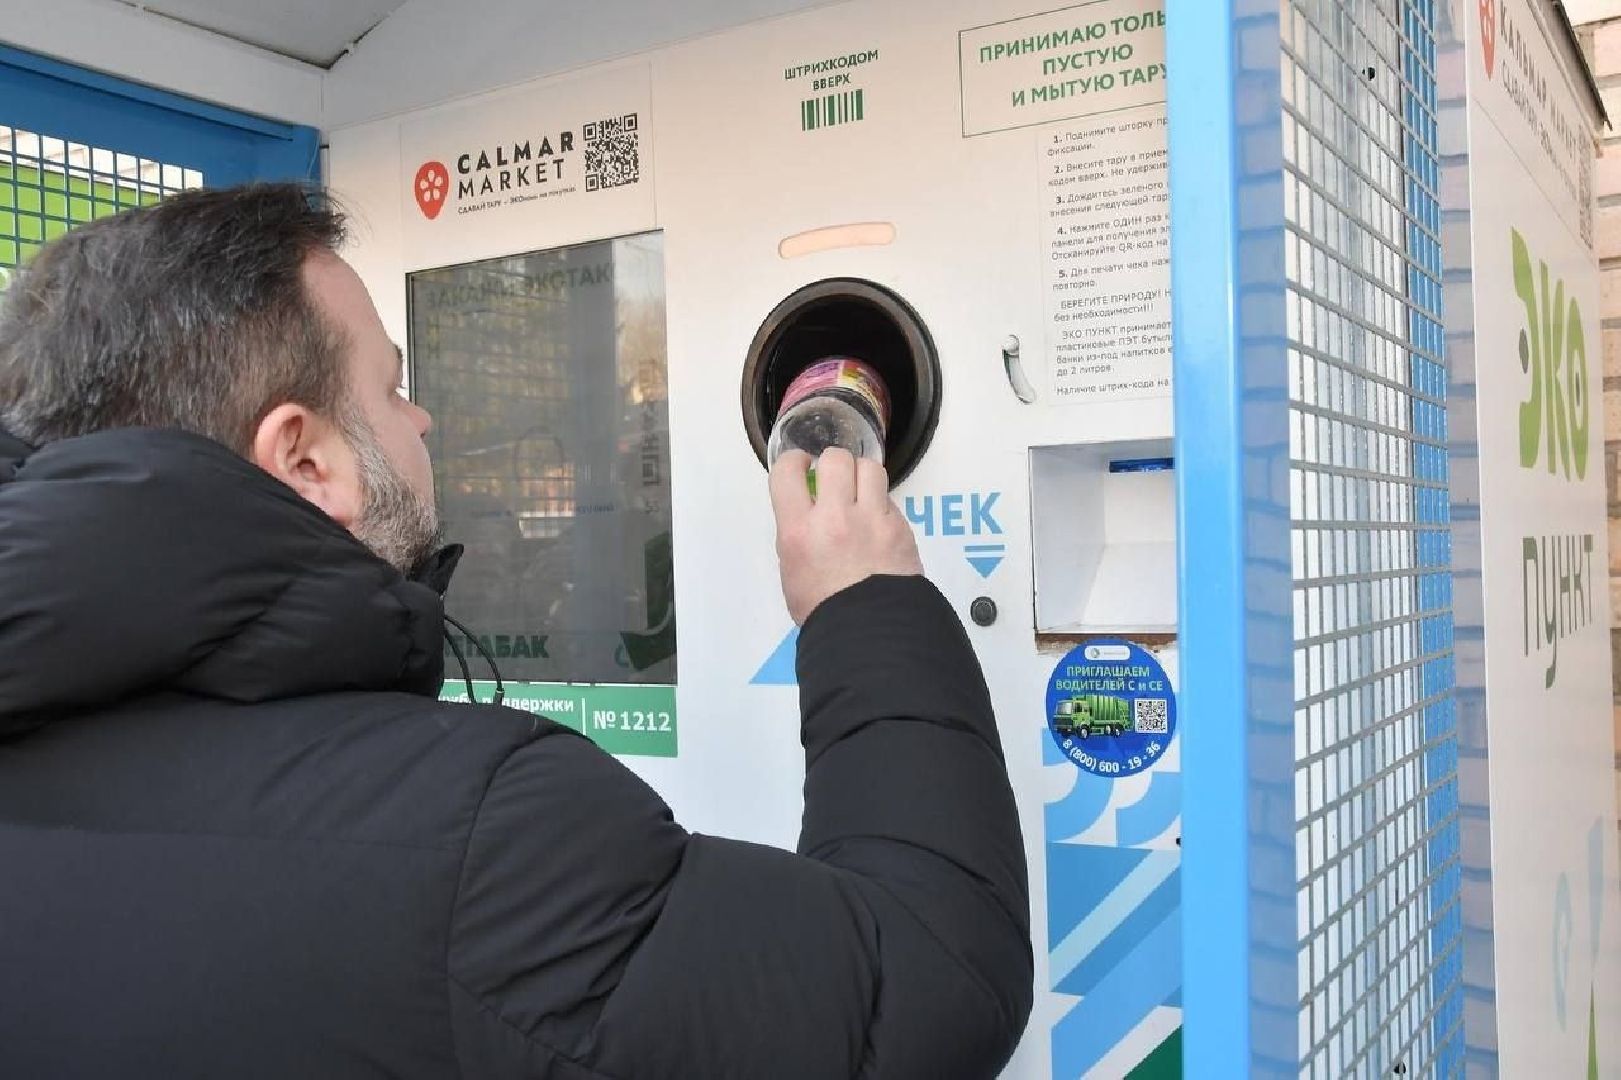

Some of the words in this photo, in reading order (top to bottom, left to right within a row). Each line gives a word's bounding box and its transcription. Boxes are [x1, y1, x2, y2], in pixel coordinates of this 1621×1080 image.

[979, 23, 1106, 63] ПРИНИМАЮ
[785, 50, 878, 79] ШТРИХКОДОМ
[1043, 44, 1133, 75] ПУСТУЮ
[813, 73, 850, 91] ВВЕРХ
[1012, 91, 1025, 107] И
[1032, 74, 1114, 103] МЫТУЮ
[457, 131, 574, 174] CALMAR
[458, 159, 565, 200] MARKET
[1061, 295, 1108, 309] БЕРЕГИТЕ
[1085, 326, 1119, 337] ПУНКТ
[905, 492, 1002, 536] ЧЕК
[1055, 678, 1125, 691] ВОДИТЕЛЕЙ
[1066, 666, 1150, 677] ПРИГЛАШАЕМ
[1062, 739, 1072, 749] 8
[1099, 761, 1119, 773] 600
[1128, 757, 1142, 769] 19
[1145, 740, 1161, 758] 36
